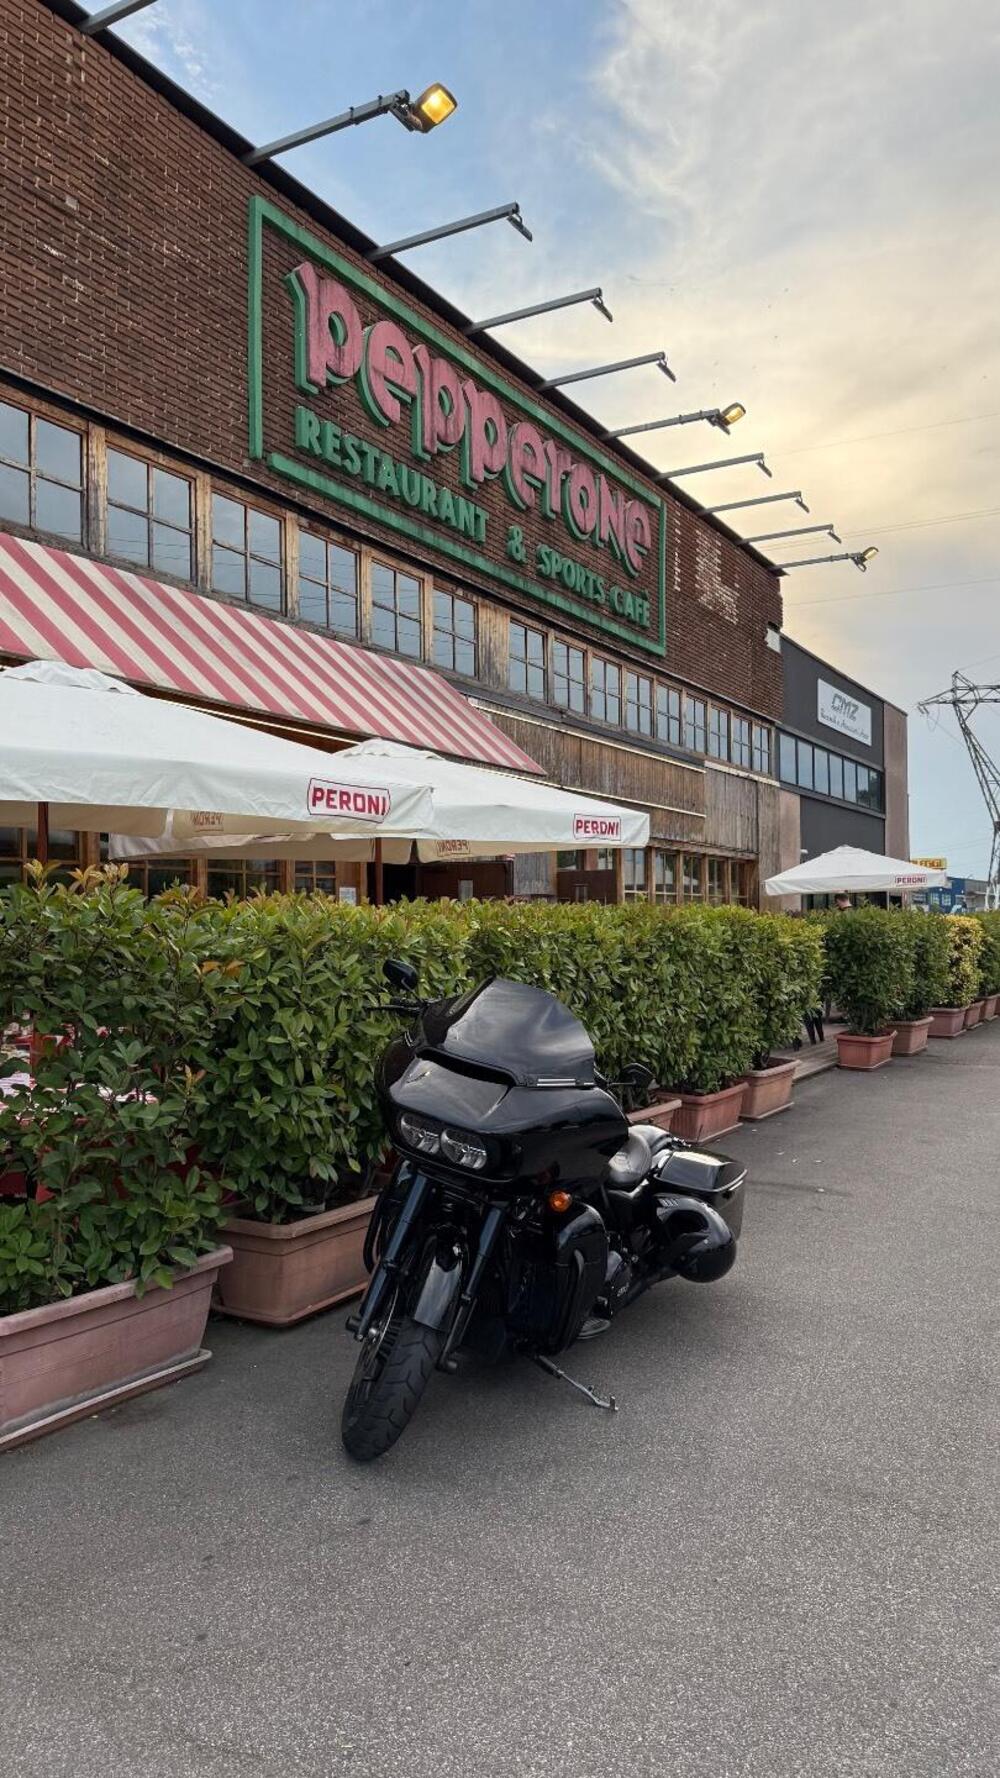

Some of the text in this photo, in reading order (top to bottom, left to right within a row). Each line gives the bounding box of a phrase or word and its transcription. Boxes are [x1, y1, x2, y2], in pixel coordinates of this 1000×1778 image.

[296, 405, 489, 542] RESTAURANT
[507, 525, 527, 562] &
[537, 544, 605, 603] SPORTS
[312, 787, 386, 815] PERONI
[576, 819, 619, 835] PERONI
